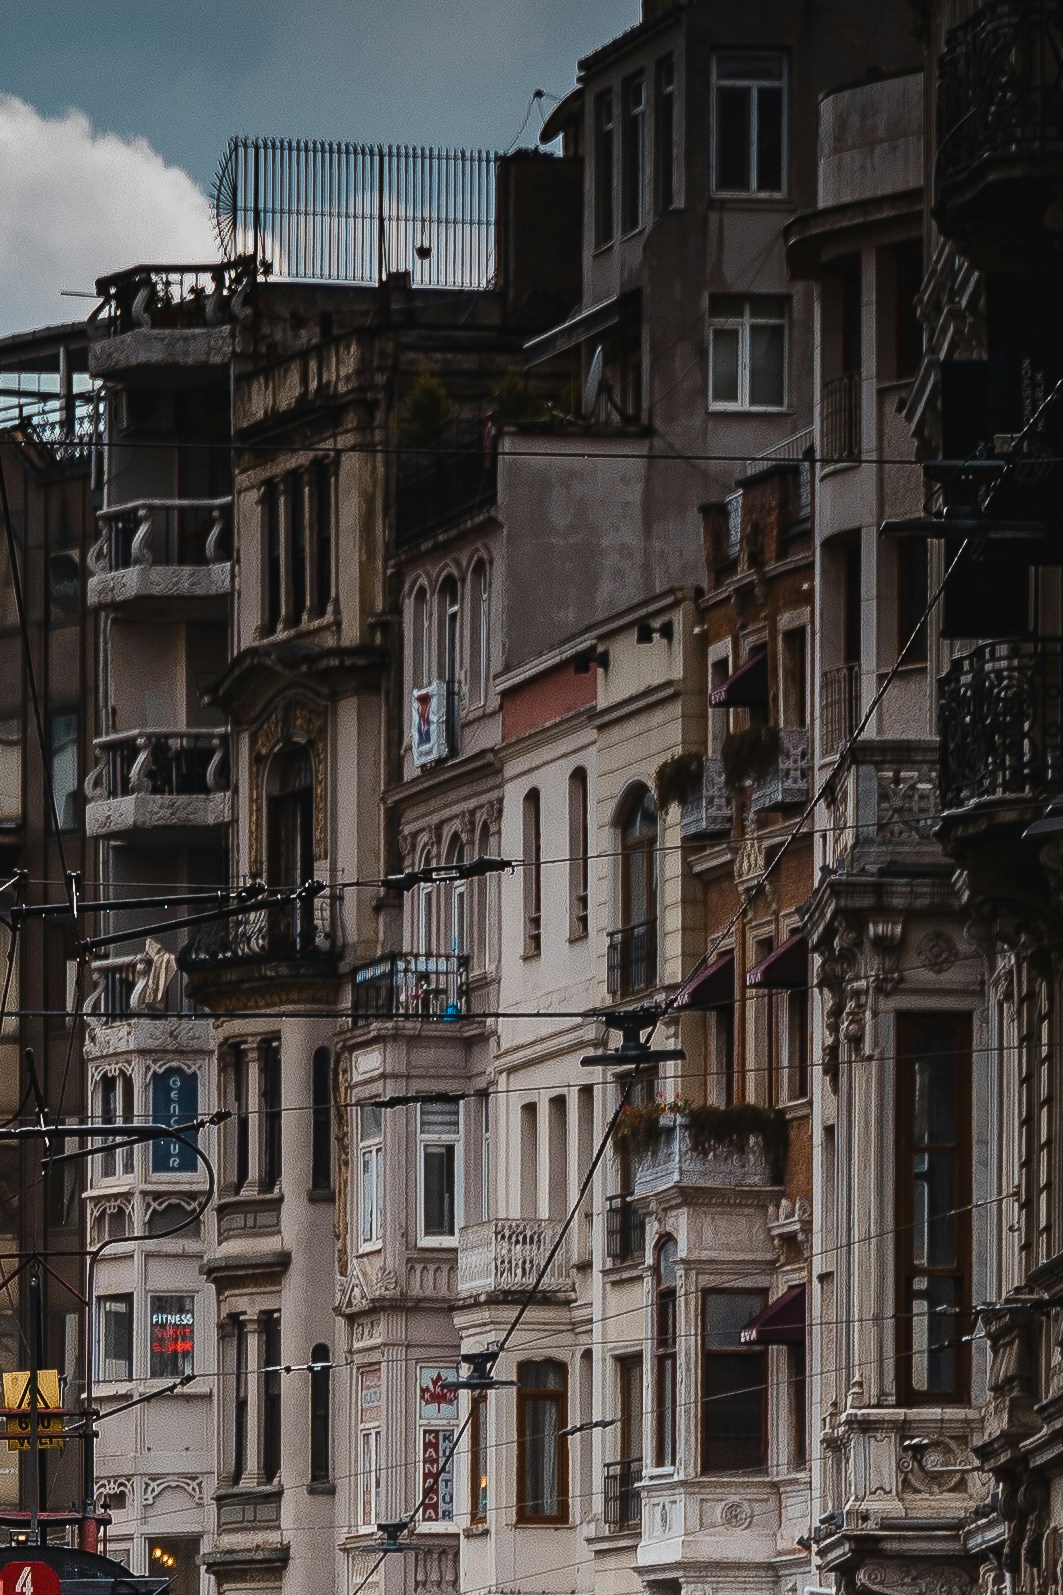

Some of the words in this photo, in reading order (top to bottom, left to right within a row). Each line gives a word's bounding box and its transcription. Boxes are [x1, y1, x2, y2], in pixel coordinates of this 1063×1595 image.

[169, 1075, 181, 1168] GENCUR
[17, 1415, 52, 1431] 60
[425, 1433, 438, 1520] KANADA
